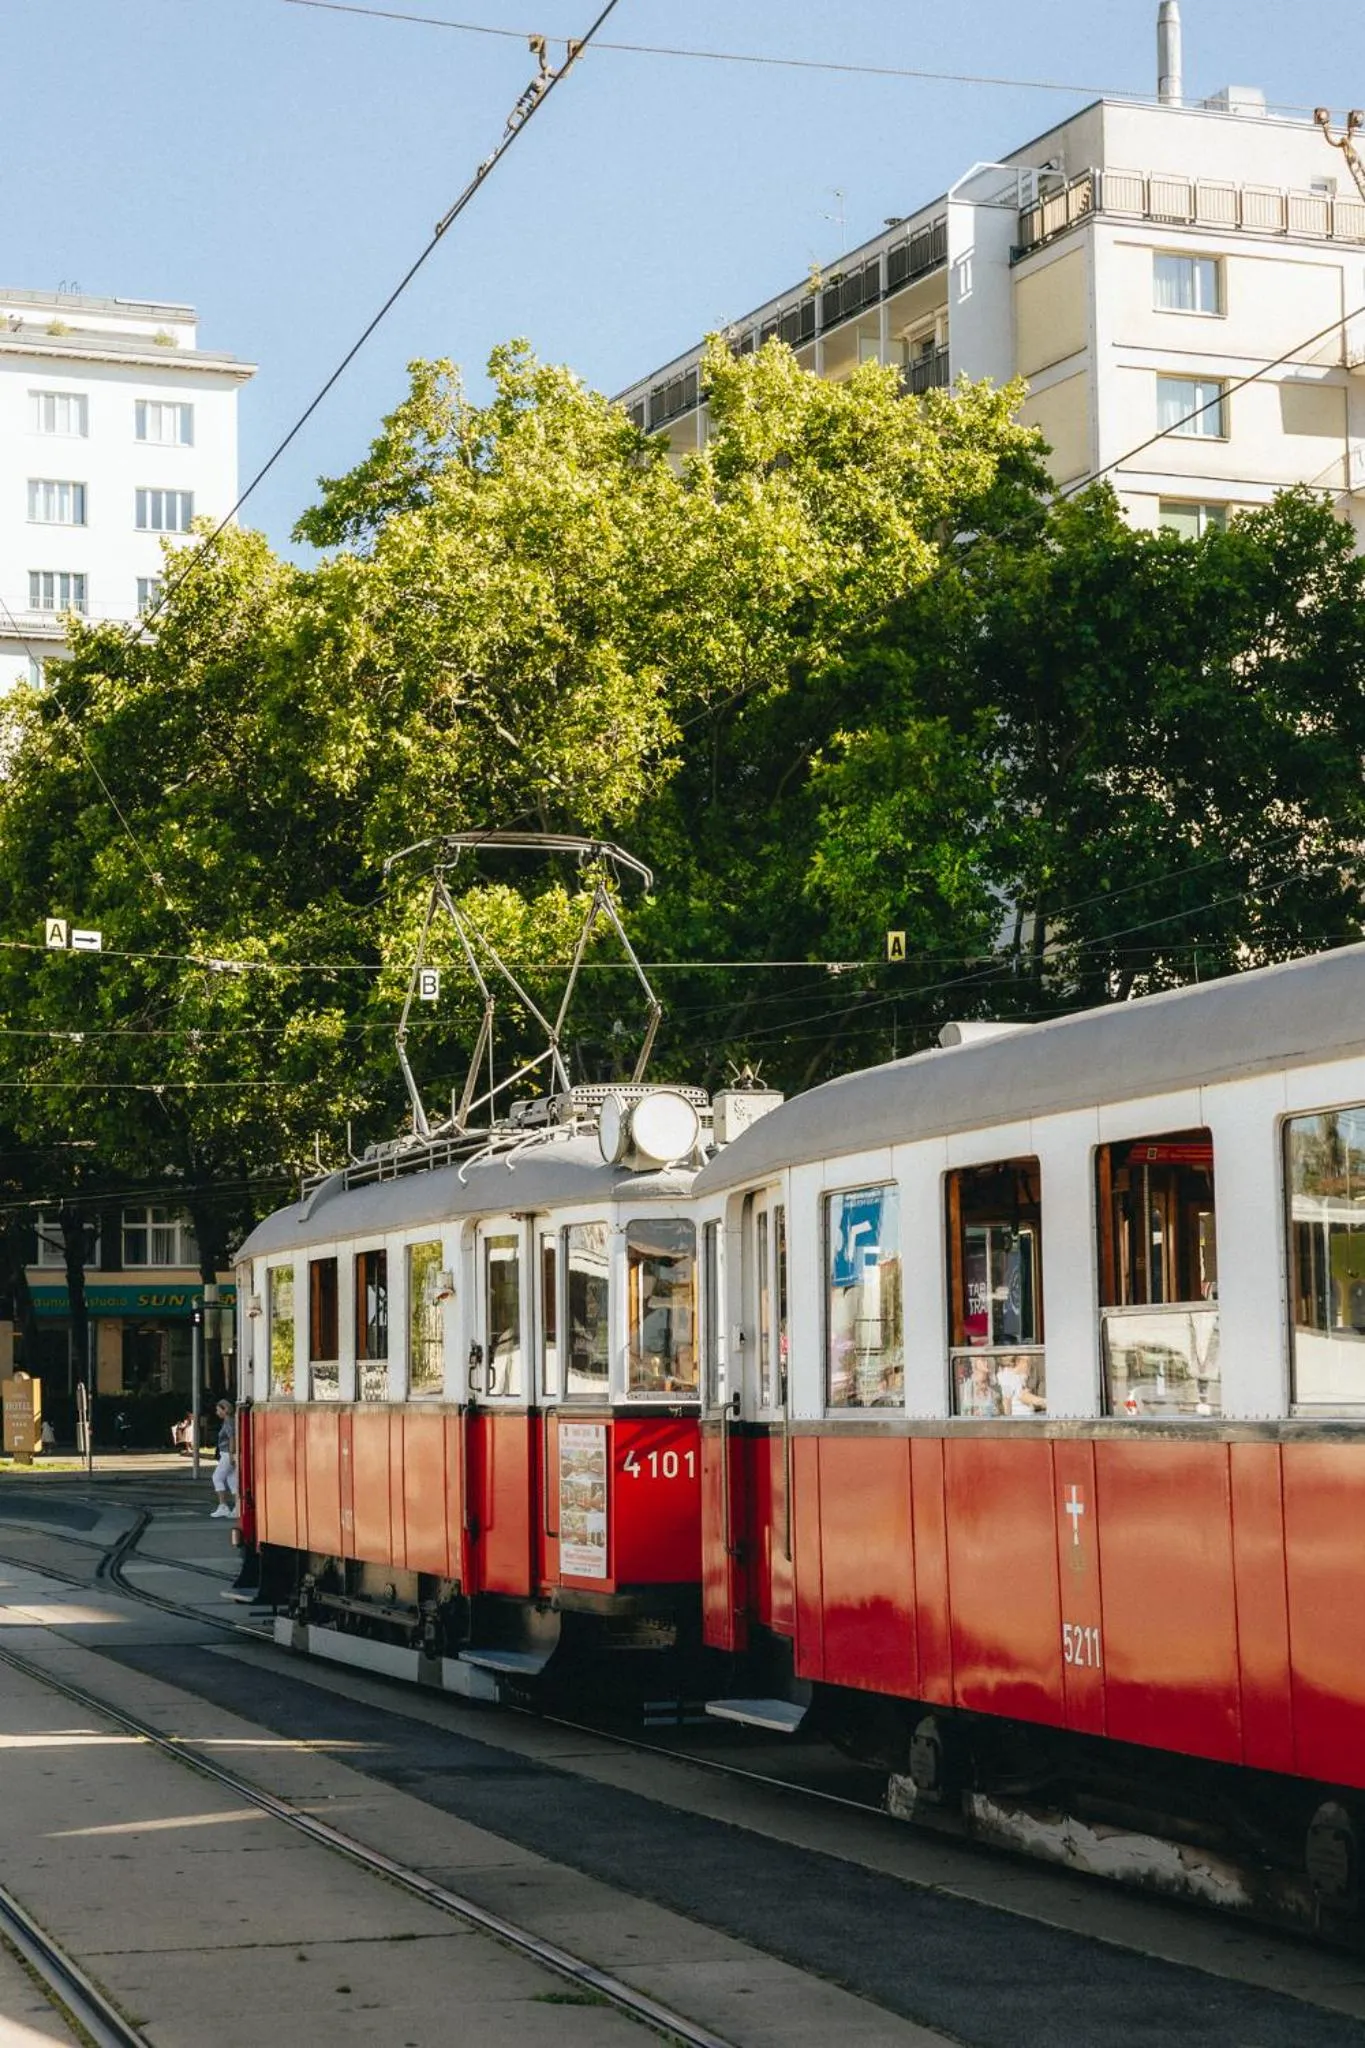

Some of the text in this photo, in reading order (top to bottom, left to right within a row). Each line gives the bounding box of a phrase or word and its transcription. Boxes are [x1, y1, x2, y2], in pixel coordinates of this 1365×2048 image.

[49, 923, 64, 942] A
[891, 936, 903, 956] A
[422, 975, 437, 995] B
[136, 1294, 185, 1307] SUN
[623, 1450, 695, 1479] 4101
[1063, 1623, 1100, 1669] 5211
